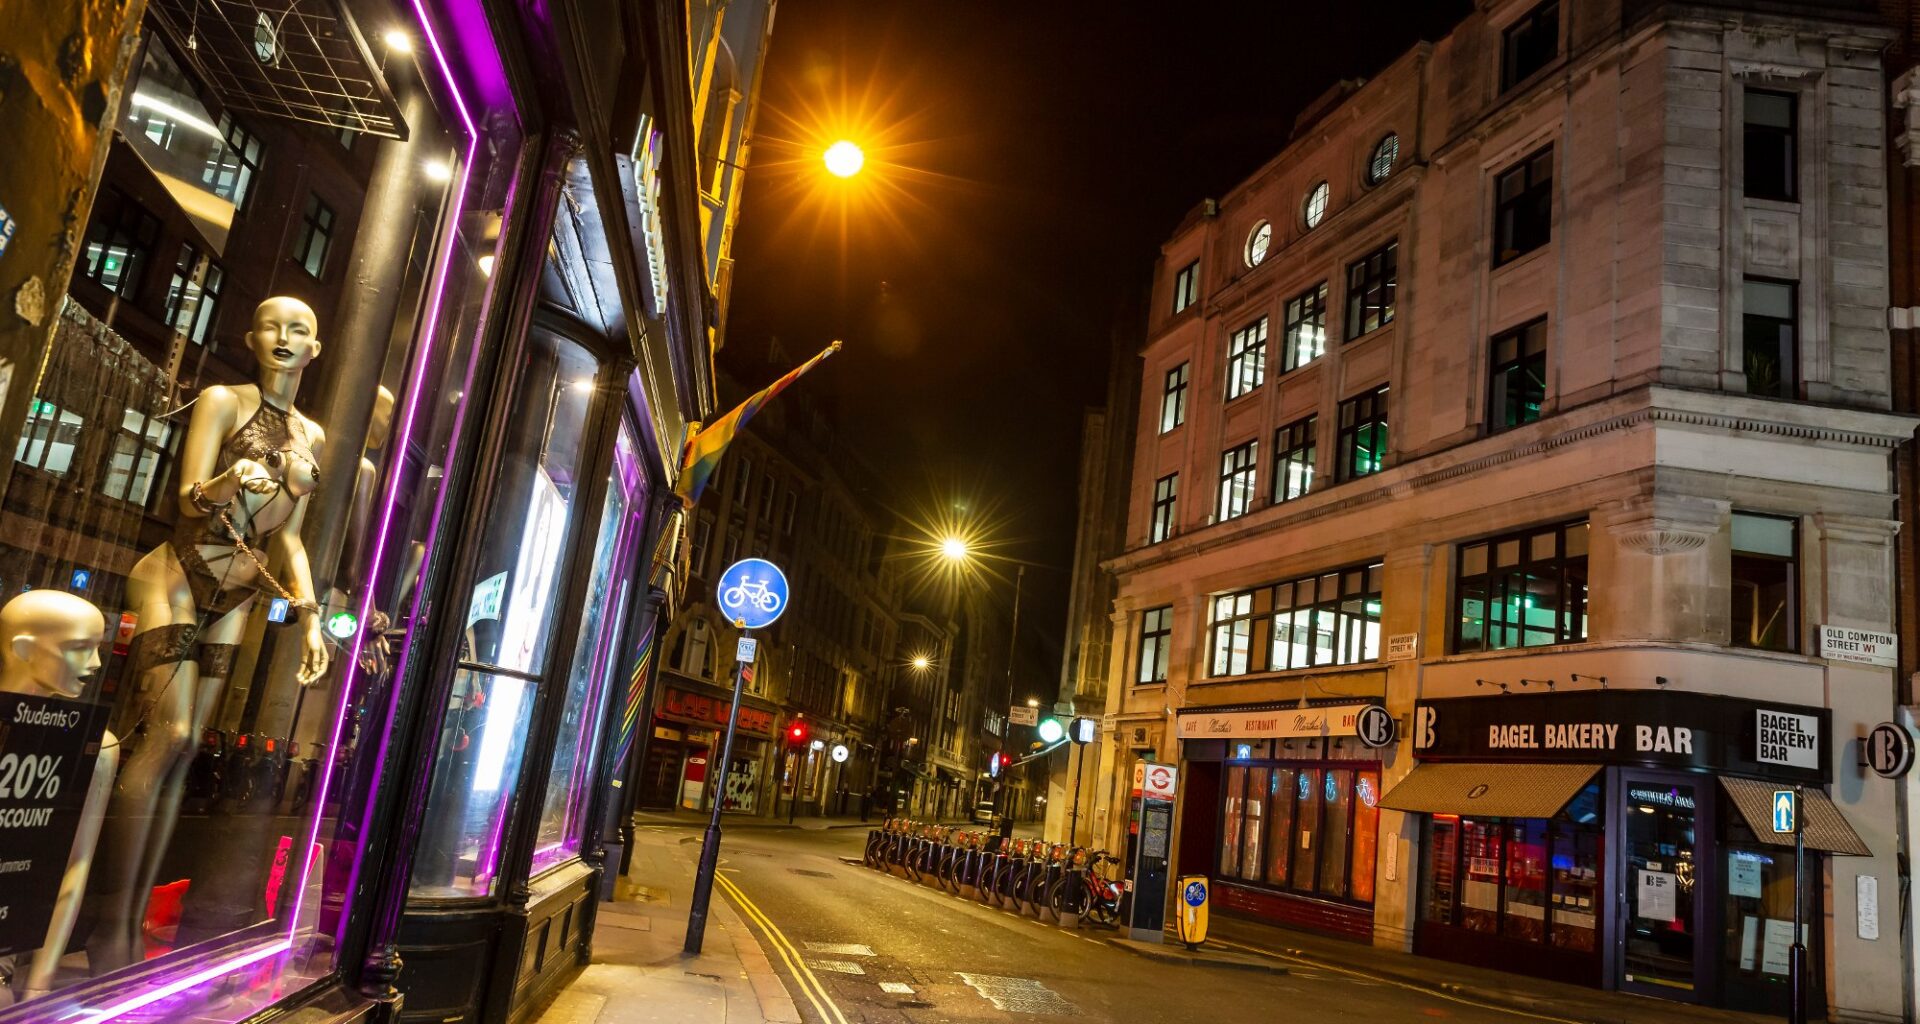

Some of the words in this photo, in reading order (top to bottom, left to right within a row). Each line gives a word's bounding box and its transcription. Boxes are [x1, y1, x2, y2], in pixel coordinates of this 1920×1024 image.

[1827, 628, 1844, 639] OLD
[1848, 631, 1892, 645] COMPTON
[1827, 639, 1860, 651] STREET
[1862, 643, 1876, 654] W1
[14, 701, 68, 728] Students
[1760, 713, 1804, 734] BAGEL
[1489, 724, 1538, 749] BAGEL
[1545, 723, 1619, 750] BAKERY
[1636, 725, 1692, 754] BAR
[1760, 729, 1815, 750] BAKERY
[1760, 743, 1788, 761] BAR
[0, 753, 63, 799] 20%
